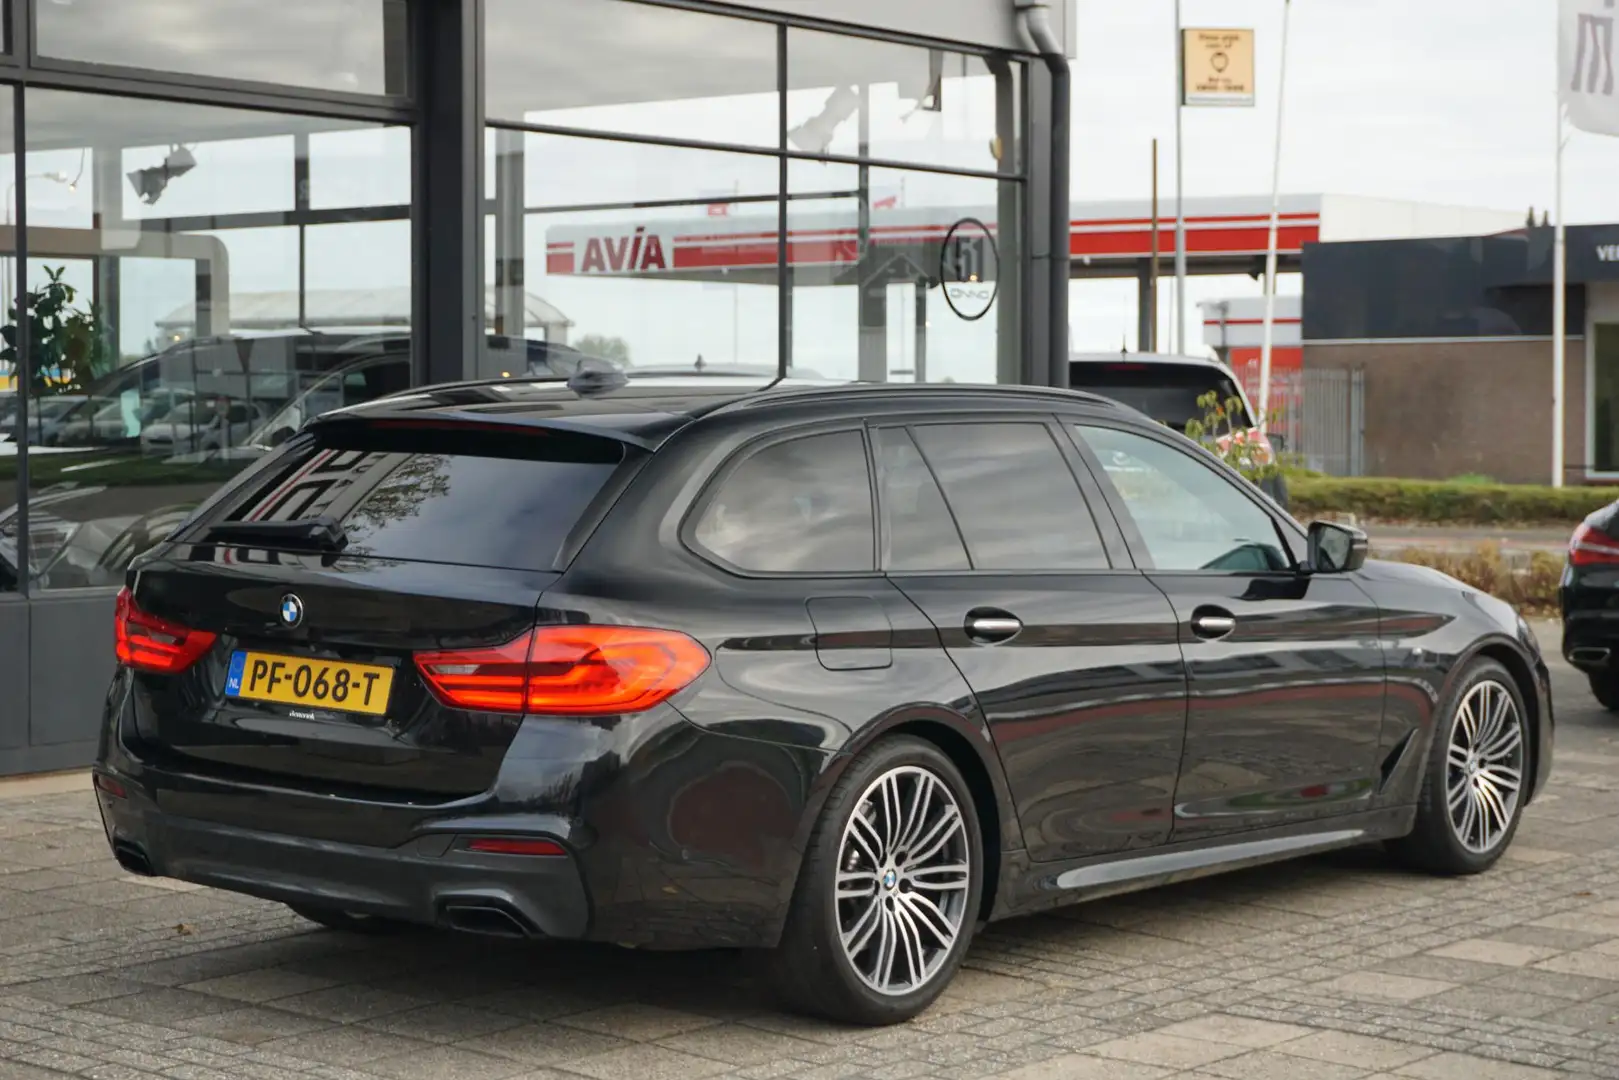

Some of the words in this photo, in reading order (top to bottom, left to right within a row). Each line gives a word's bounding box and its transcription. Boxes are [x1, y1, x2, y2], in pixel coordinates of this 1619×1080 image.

[1596, 244, 1619, 261] VE
[228, 677, 239, 689] NL
[249, 659, 380, 706] PF-068-T
